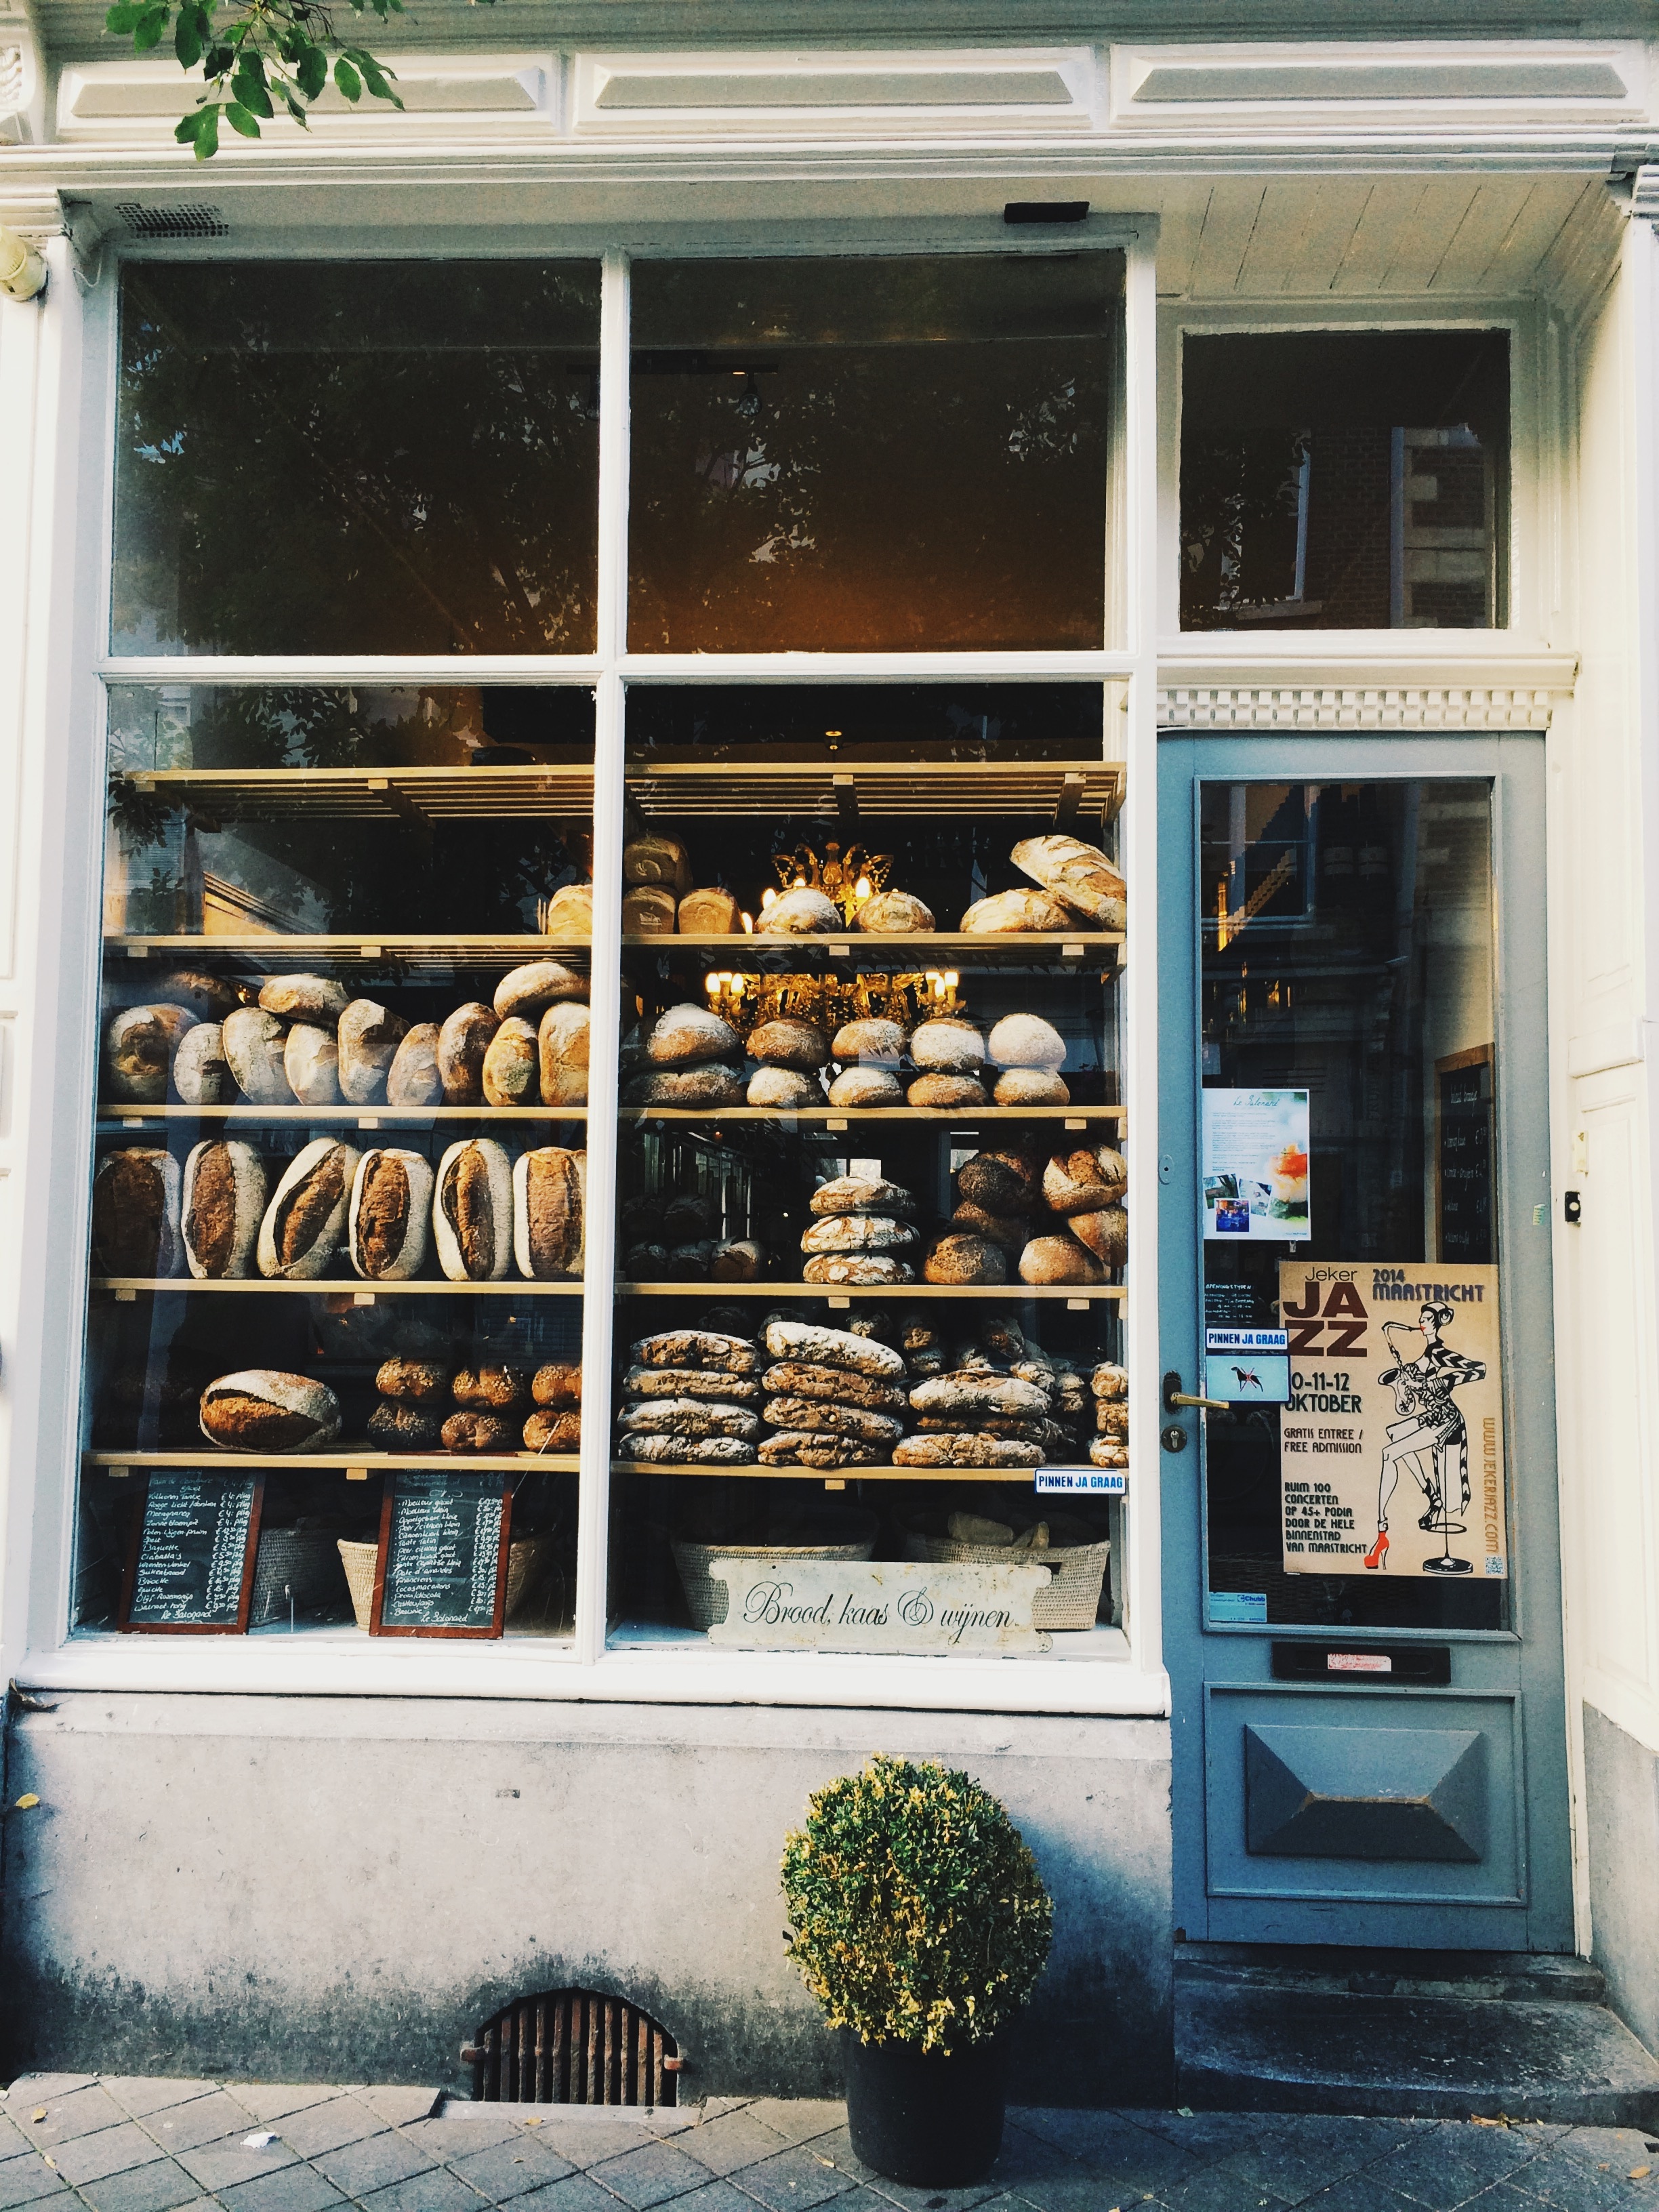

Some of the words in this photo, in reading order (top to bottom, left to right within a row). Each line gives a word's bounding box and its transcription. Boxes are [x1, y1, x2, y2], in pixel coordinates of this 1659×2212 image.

[1305, 1267, 1358, 1282] Jeker
[1372, 1269, 1405, 1283] 2014
[1283, 1281, 1369, 1318] JA
[1372, 1284, 1486, 1303] MAASTRICHT
[1208, 1332, 1240, 1344] PINNEN
[1242, 1333, 1254, 1344] JA
[1256, 1334, 1286, 1345] GRAAG
[1284, 1319, 1368, 1357] ZZ
[1291, 1372, 1350, 1391] 0-11-12
[1284, 1393, 1361, 1413] OKTOBER
[1284, 1427, 1314, 1439] GRATIS
[1318, 1428, 1355, 1440] ENTREE
[1284, 1441, 1309, 1452] FREE
[1312, 1442, 1362, 1454] ADMISSION
[1039, 1475, 1073, 1488] PINNEN
[1076, 1476, 1088, 1488] JA
[1090, 1476, 1123, 1488] GRAAG
[1284, 1481, 1310, 1492] RUIM
[1313, 1483, 1332, 1493] 100
[1284, 1494, 1339, 1505] CONCERTEN
[1285, 1506, 1298, 1516] OP
[1301, 1506, 1321, 1517] 45+
[1324, 1507, 1353, 1517] PODIA
[1285, 1517, 1310, 1528] DOOR
[1313, 1519, 1327, 1529] DE
[1330, 1519, 1355, 1530] HELE
[1286, 1530, 1342, 1541] BINNENSTAD
[1286, 1542, 1305, 1553] VAN
[1308, 1542, 1368, 1553] MAASTRICHT
[743, 1581, 832, 1626] Brood,
[838, 1594, 888, 1625] kaas
[940, 1603, 1014, 1645] wijnen
